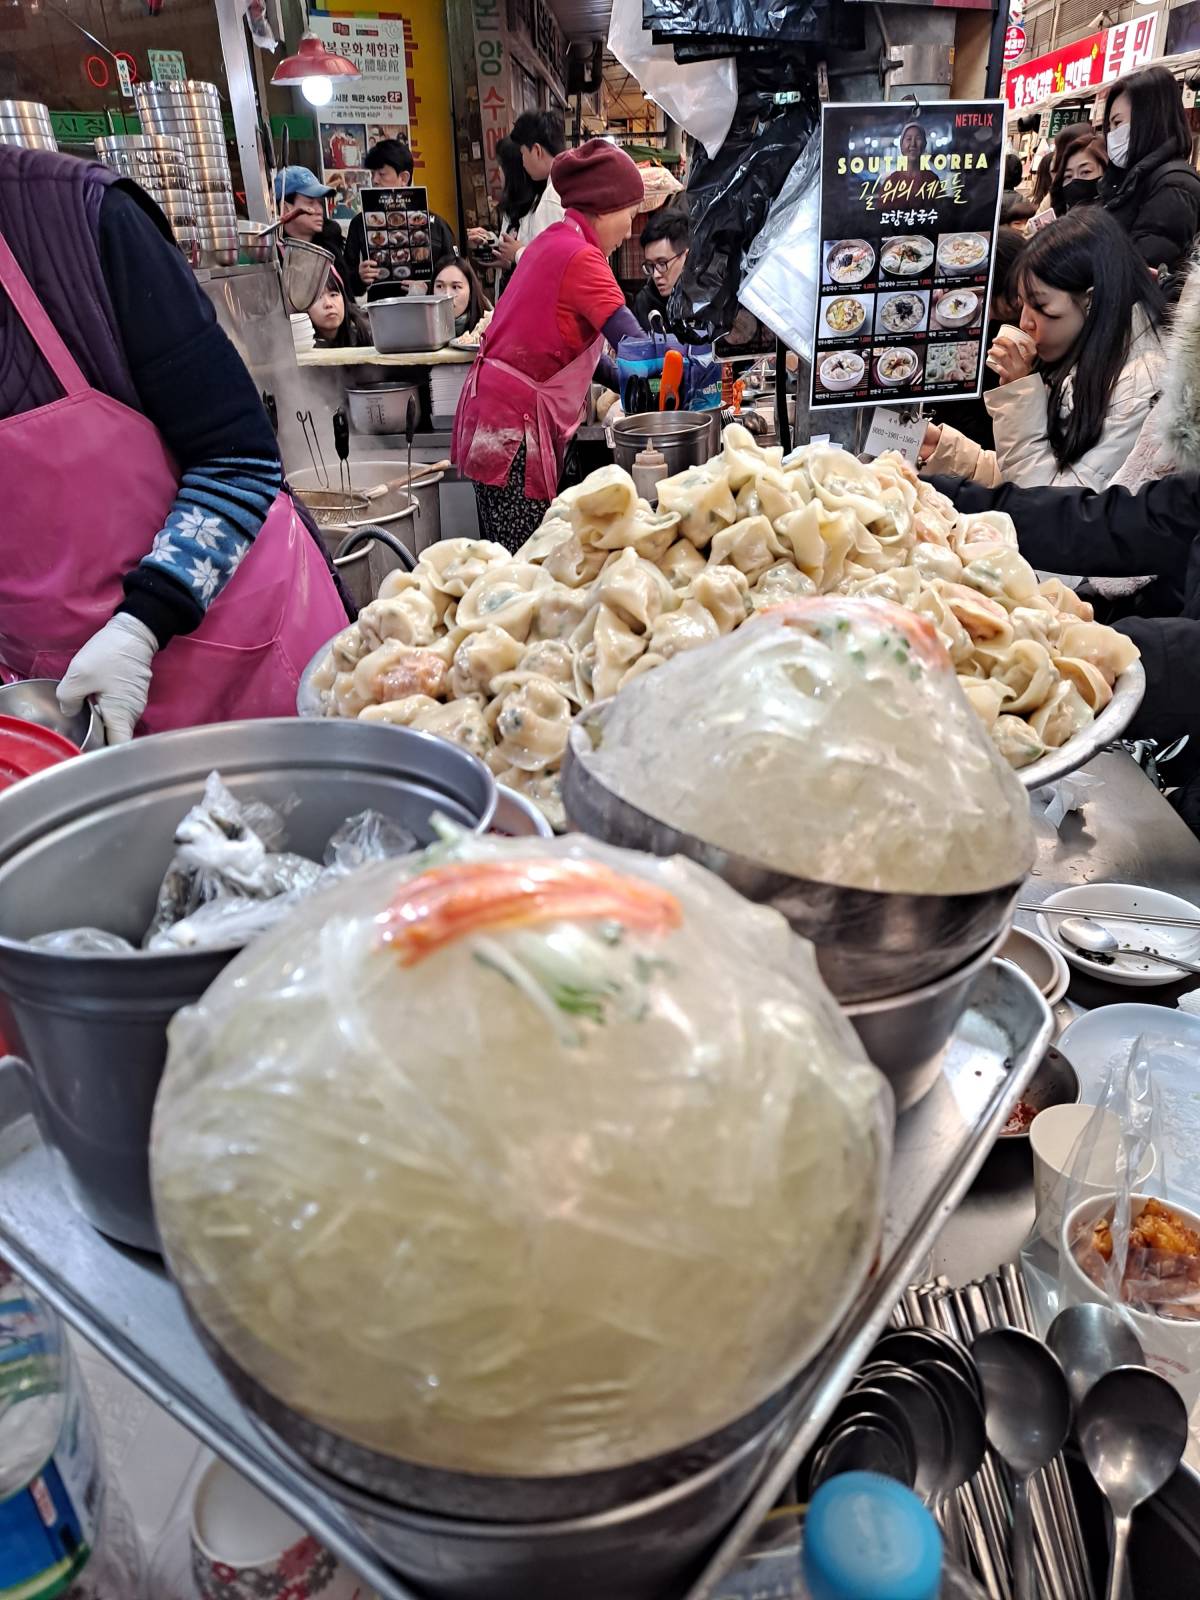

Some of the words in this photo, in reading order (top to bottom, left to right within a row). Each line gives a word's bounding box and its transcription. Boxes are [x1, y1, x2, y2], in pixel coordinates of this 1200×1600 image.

[341, 41, 363, 57] 문화
[366, 42, 400, 58] 체험관
[354, 59, 400, 73] 化體驗館
[389, 92, 401, 101] 2F
[955, 113, 993, 128] NETFLIX
[1041, 120, 1049, 128] 22
[837, 154, 909, 175] SOUTH
[919, 152, 989, 171] KOREA
[858, 174, 882, 211] 길
[880, 178, 915, 204] 위의
[914, 171, 968, 204] 셰프들
[879, 208, 939, 226] 고향칼국수
